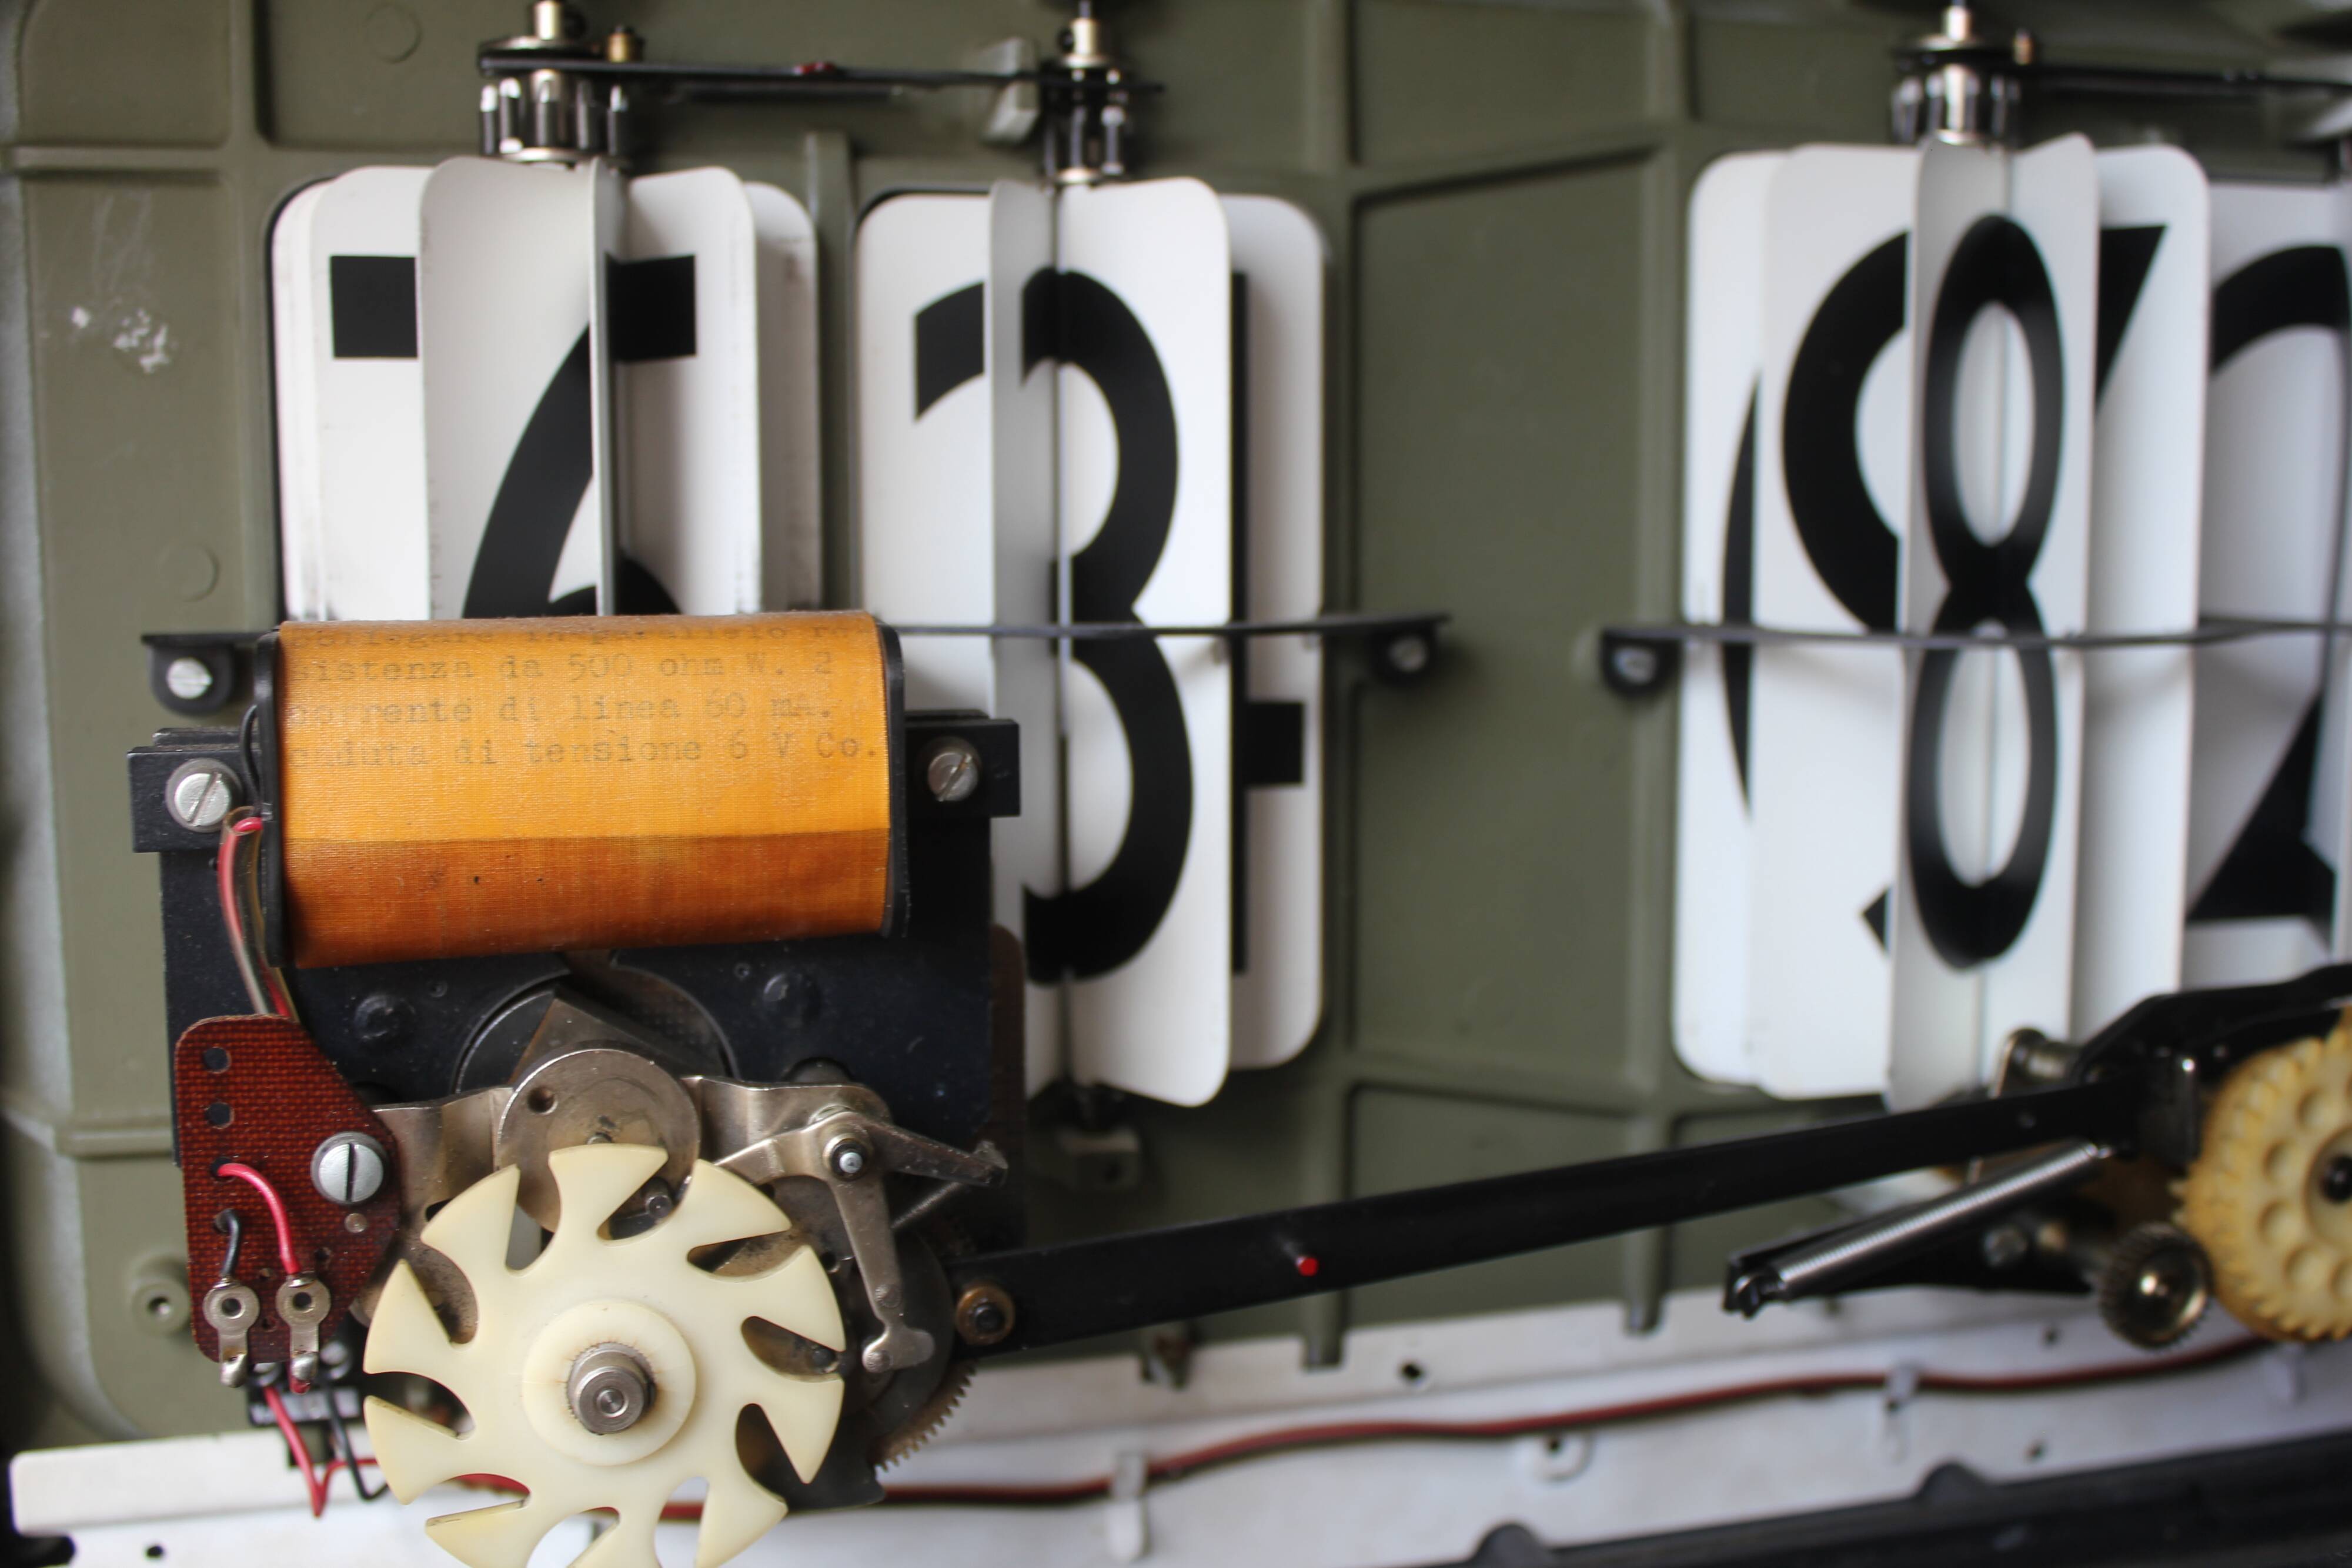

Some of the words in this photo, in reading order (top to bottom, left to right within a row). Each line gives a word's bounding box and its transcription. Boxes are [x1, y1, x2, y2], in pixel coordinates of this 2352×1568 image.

[1907, 212, 2066, 973] 8
[499, 654, 543, 679] da
[567, 653, 633, 682] 500
[659, 653, 724, 677] ohm
[499, 696, 541, 722] di
[570, 694, 681, 721] linea
[455, 738, 497, 765] di
[522, 736, 701, 764] tensione
[729, 730, 748, 759] 6
